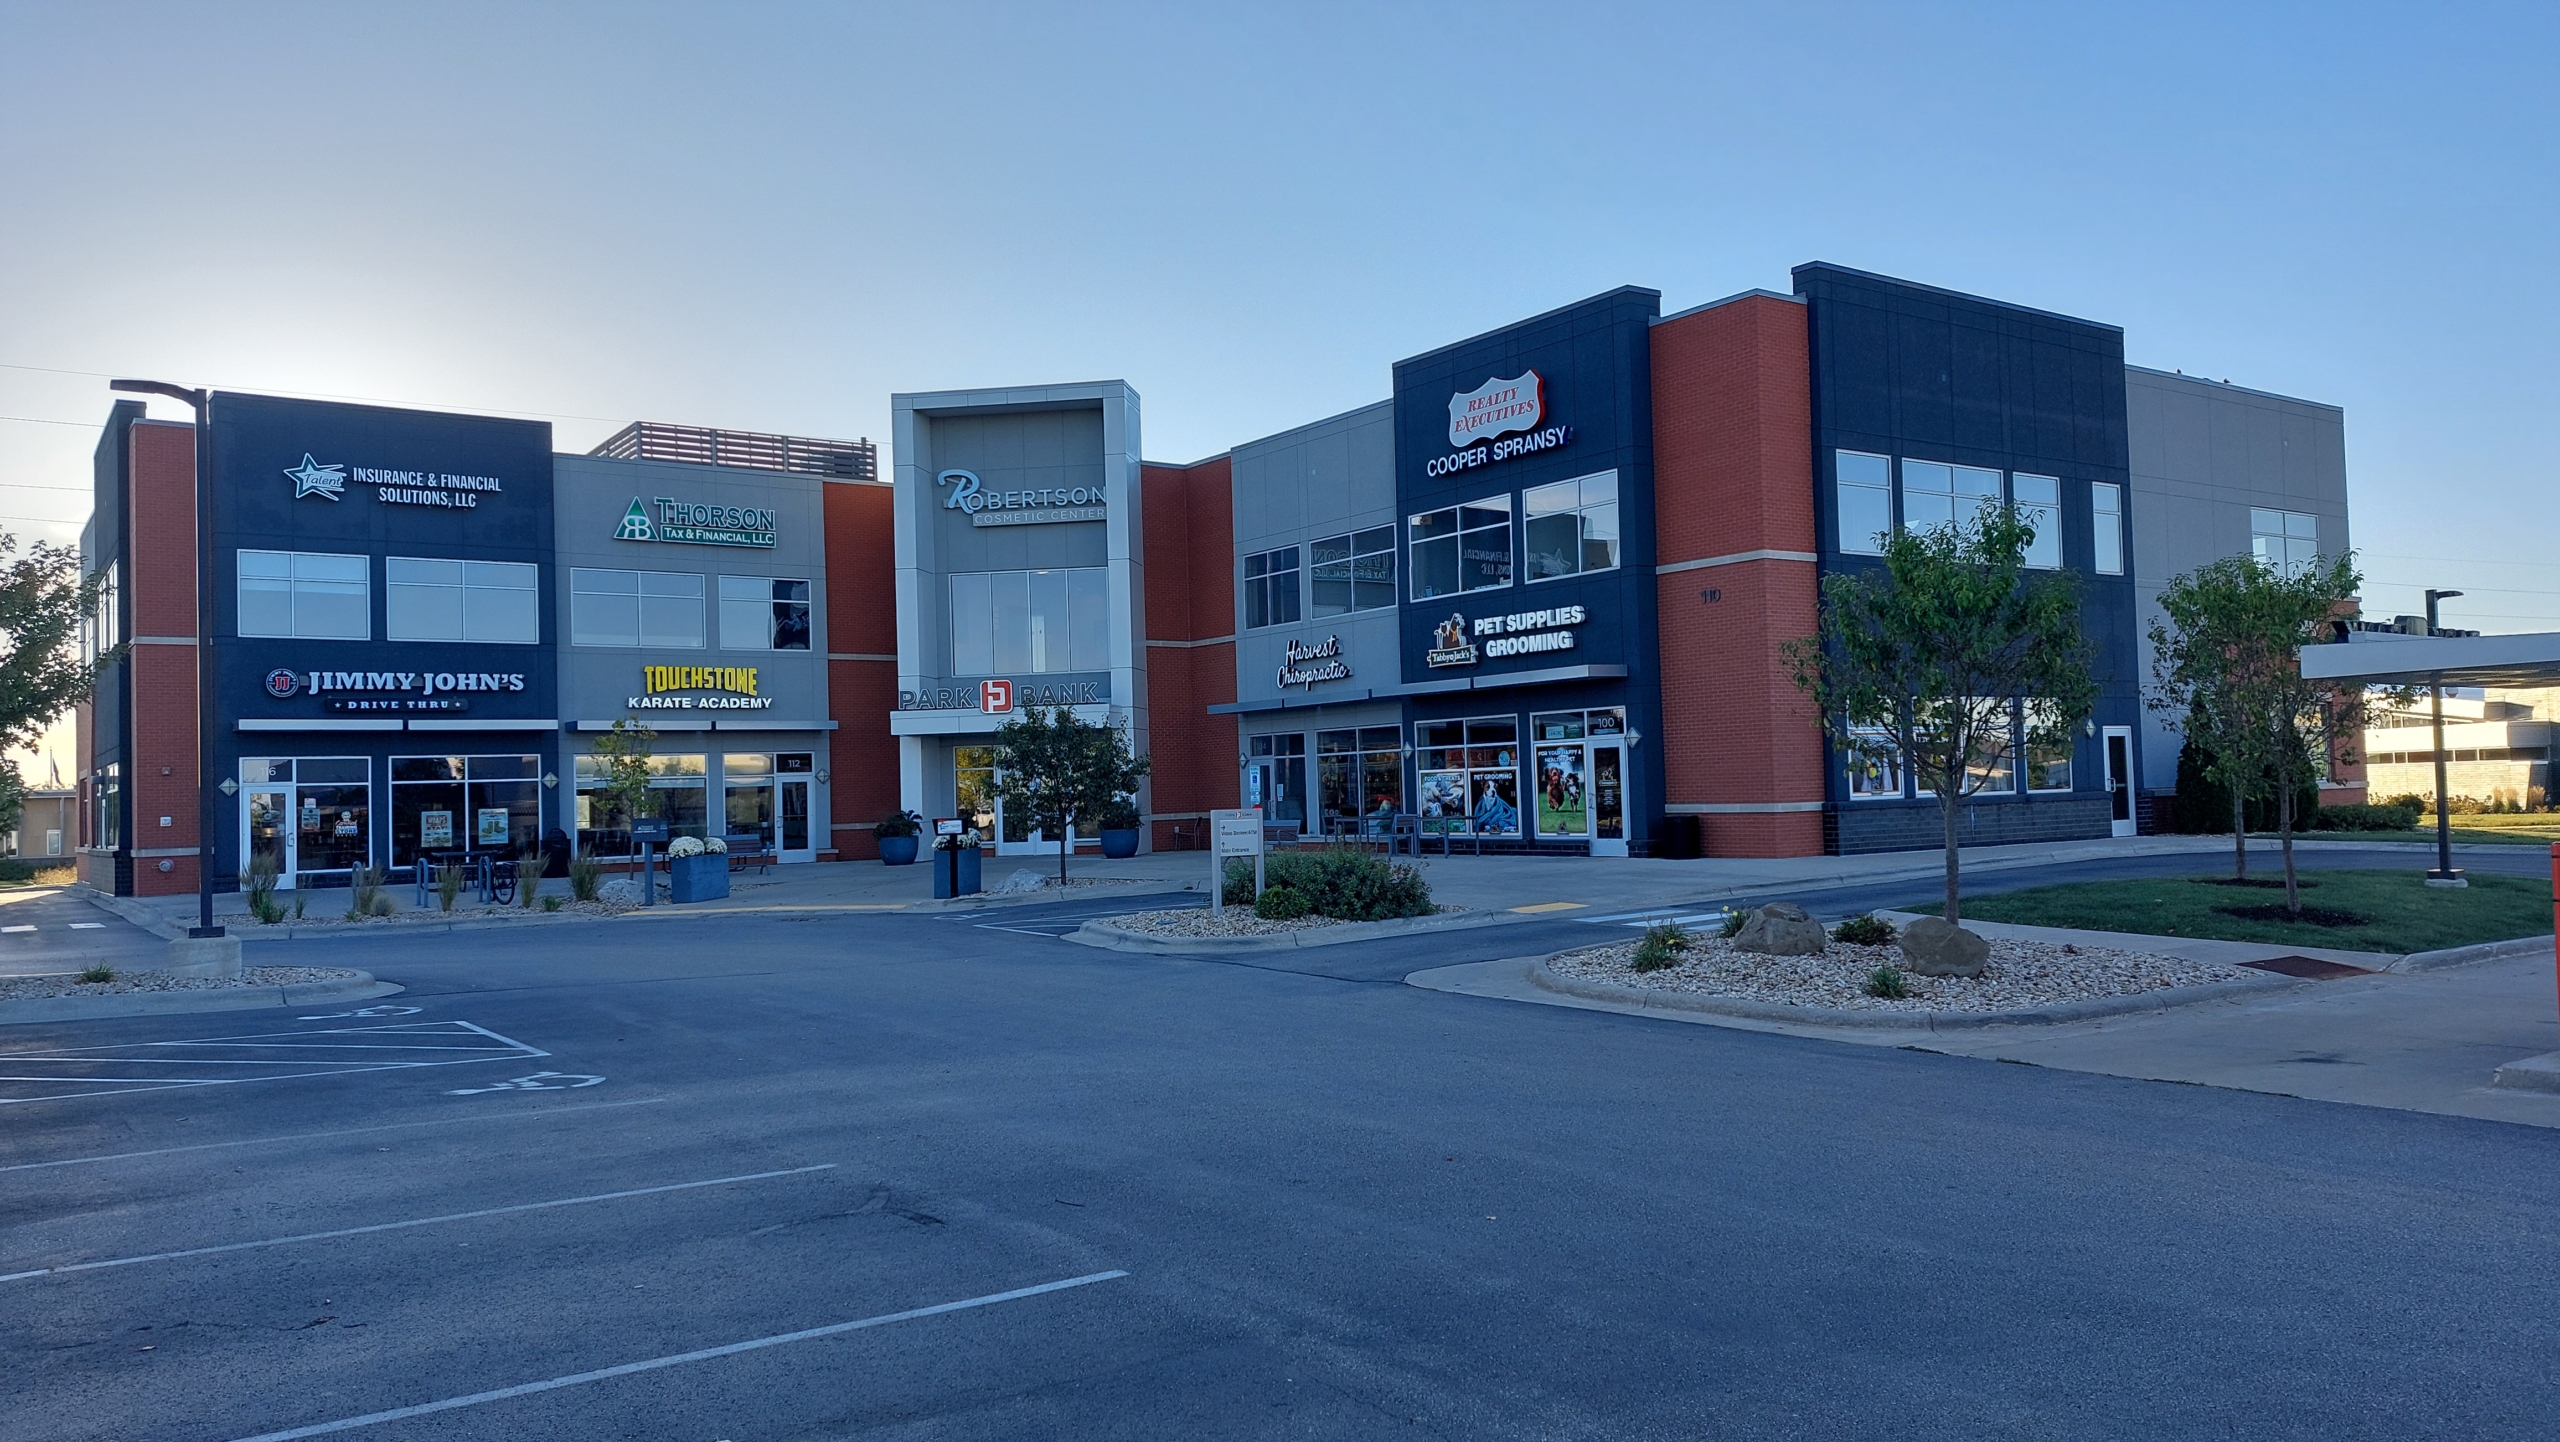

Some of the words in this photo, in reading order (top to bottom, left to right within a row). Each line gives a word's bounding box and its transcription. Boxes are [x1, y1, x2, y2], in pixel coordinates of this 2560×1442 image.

[1467, 387, 1519, 413] REALTY
[1454, 399, 1534, 433] EXECUTIVES
[1427, 447, 1487, 477] COOPER
[1493, 425, 1567, 460] SPRANSY
[304, 473, 343, 488] Talent
[353, 467, 423, 486] INSURANCE
[428, 473, 437, 487] &
[441, 474, 502, 492] FINANCIAL
[379, 487, 452, 508] SOLUTIONS,
[455, 493, 477, 508] LLC
[937, 469, 1106, 515] ROBERTSON
[654, 496, 776, 531] THORSON
[974, 512, 1045, 524] COSMETIC
[1050, 509, 1105, 520] CENTER
[686, 529, 694, 539] &
[752, 533, 774, 544] LLC
[1702, 589, 1721, 603] 110
[1474, 616, 1505, 636] PET
[1506, 605, 1585, 632] SUPPLIES
[1286, 635, 1335, 665] Harvest
[1486, 631, 1574, 657] GROOMING
[275, 676, 290, 690] JJ
[308, 672, 416, 695] JIMMY
[423, 673, 525, 695] JOHN'S
[644, 666, 758, 696] TOUCHSTONE
[1277, 660, 1347, 691] Chiropractic
[348, 701, 399, 709] DRIVE
[407, 701, 449, 709] THRU
[628, 697, 692, 709] KARATE
[697, 697, 772, 709] ACADEMY
[899, 686, 975, 710] PARK
[1018, 681, 1099, 705] BANK
[1598, 718, 1614, 728] 100
[261, 767, 277, 776] 116
[788, 760, 800, 768] 112
